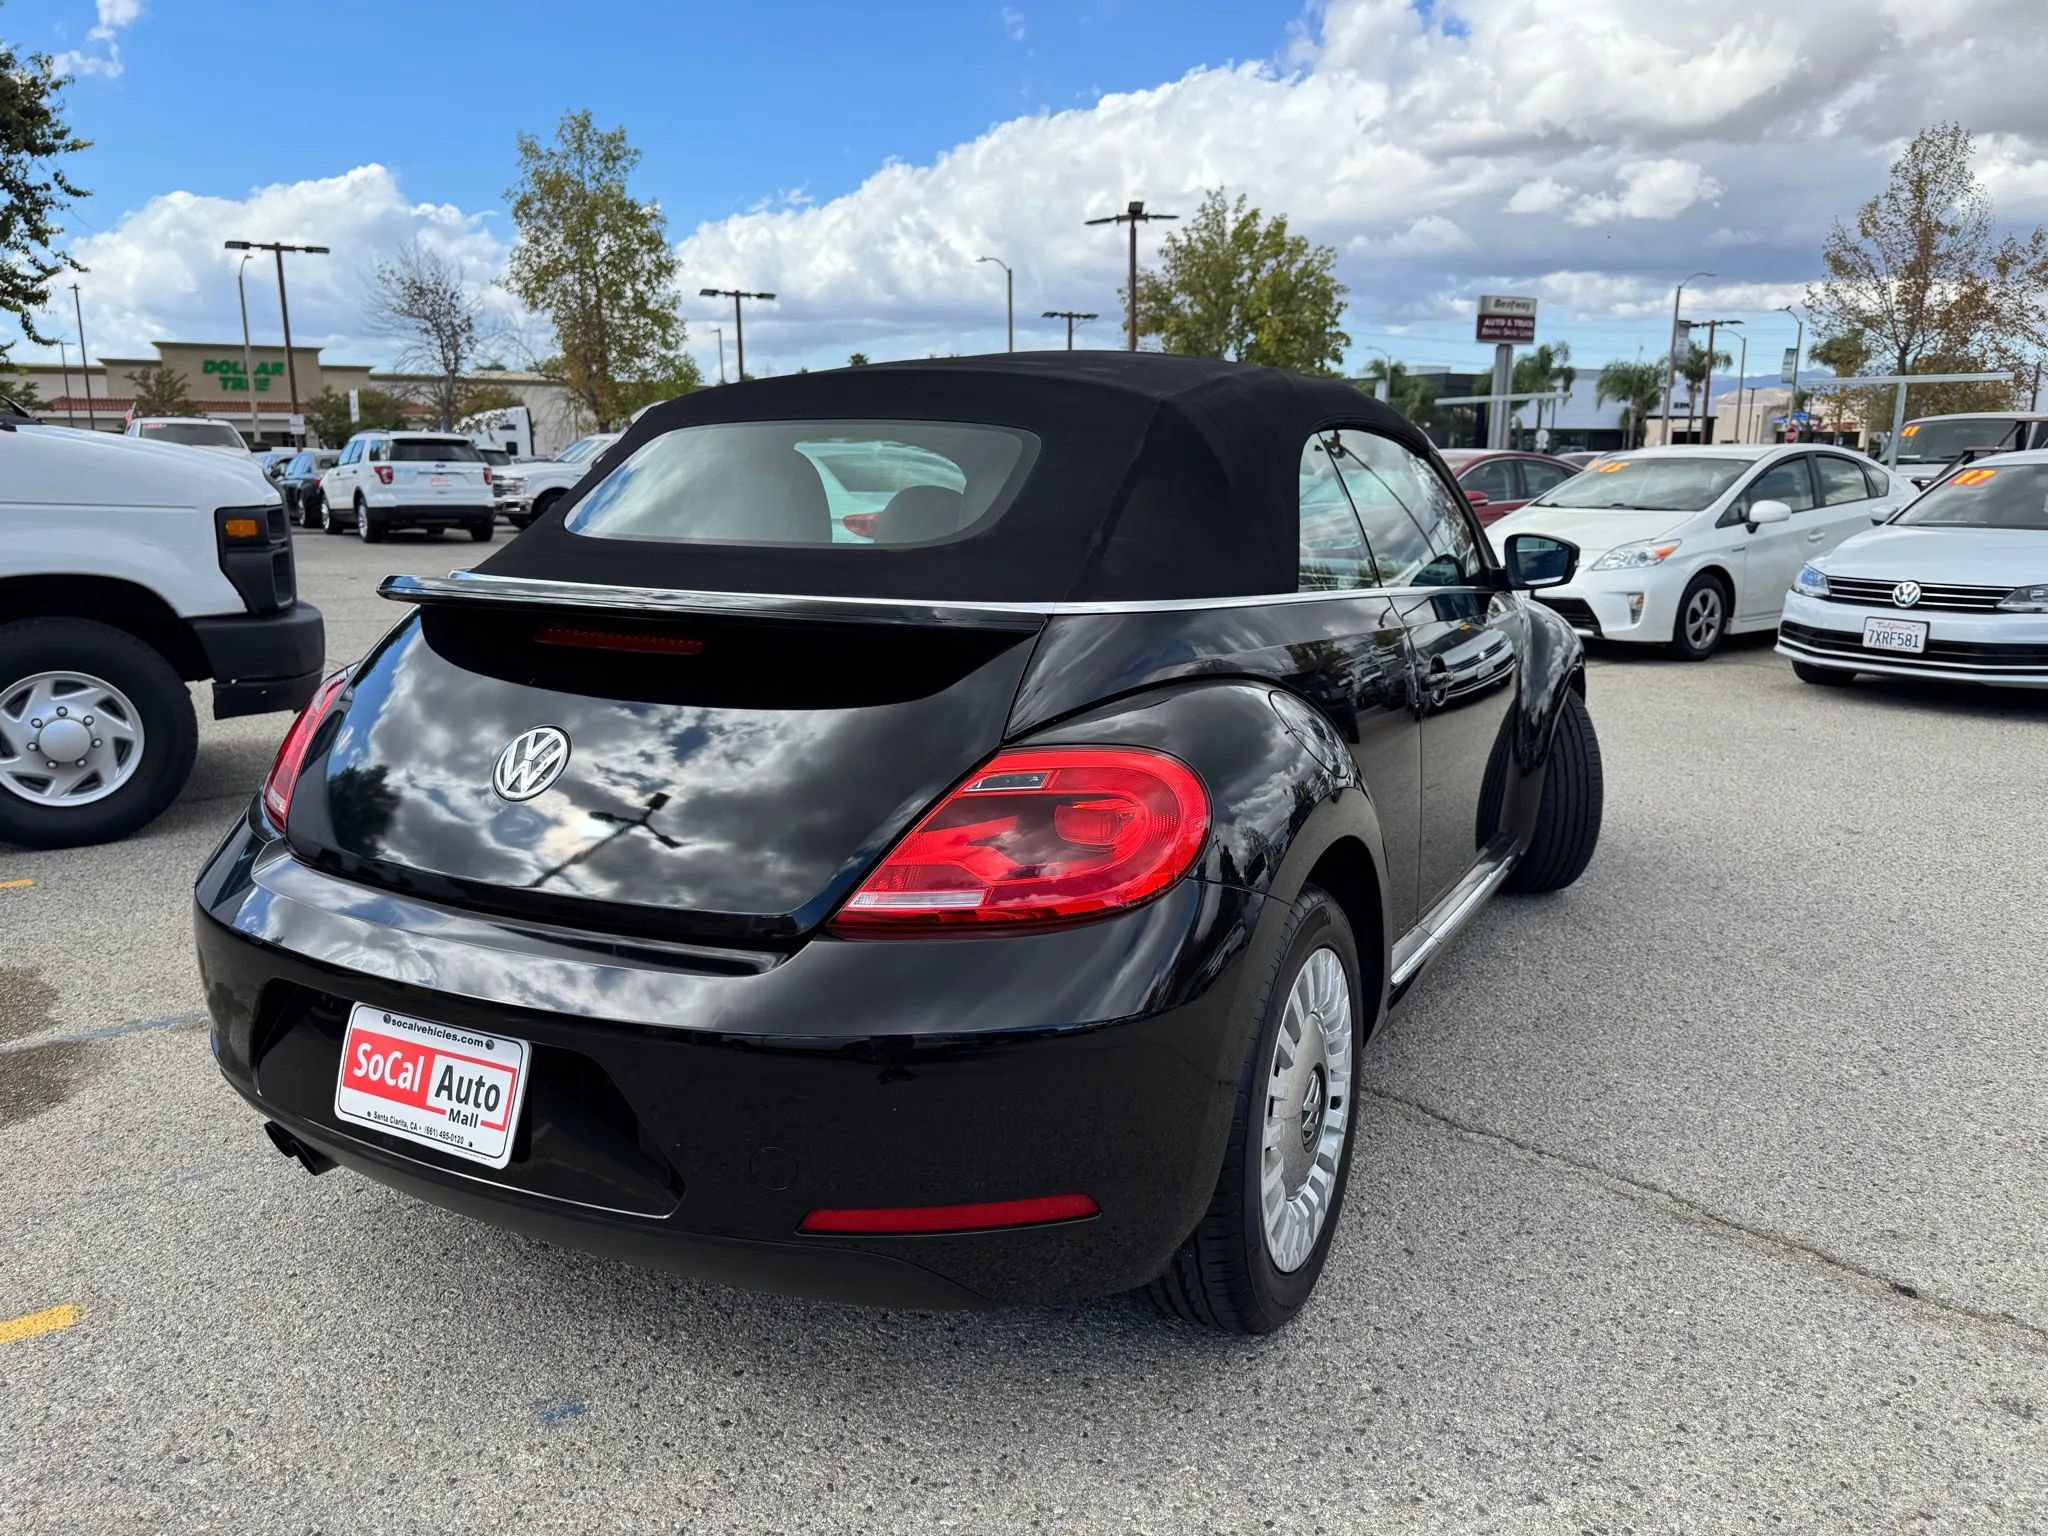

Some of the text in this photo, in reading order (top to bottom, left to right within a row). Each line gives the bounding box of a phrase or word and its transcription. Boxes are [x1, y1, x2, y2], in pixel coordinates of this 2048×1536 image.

[202, 360, 284, 375] DOLLAR
[1948, 468, 2000, 487] 17
[1868, 629, 1920, 649] 7XRF581
[391, 1018, 484, 1048] socalvehicles.com
[352, 1042, 425, 1093] SoCal
[434, 1064, 501, 1112] Auto
[373, 1111, 389, 1122] Santa
[389, 1115, 408, 1130] Clarita,
[409, 1121, 418, 1131] CA
[438, 1130, 465, 1145] 495-0120
[448, 1108, 479, 1129] Mall
